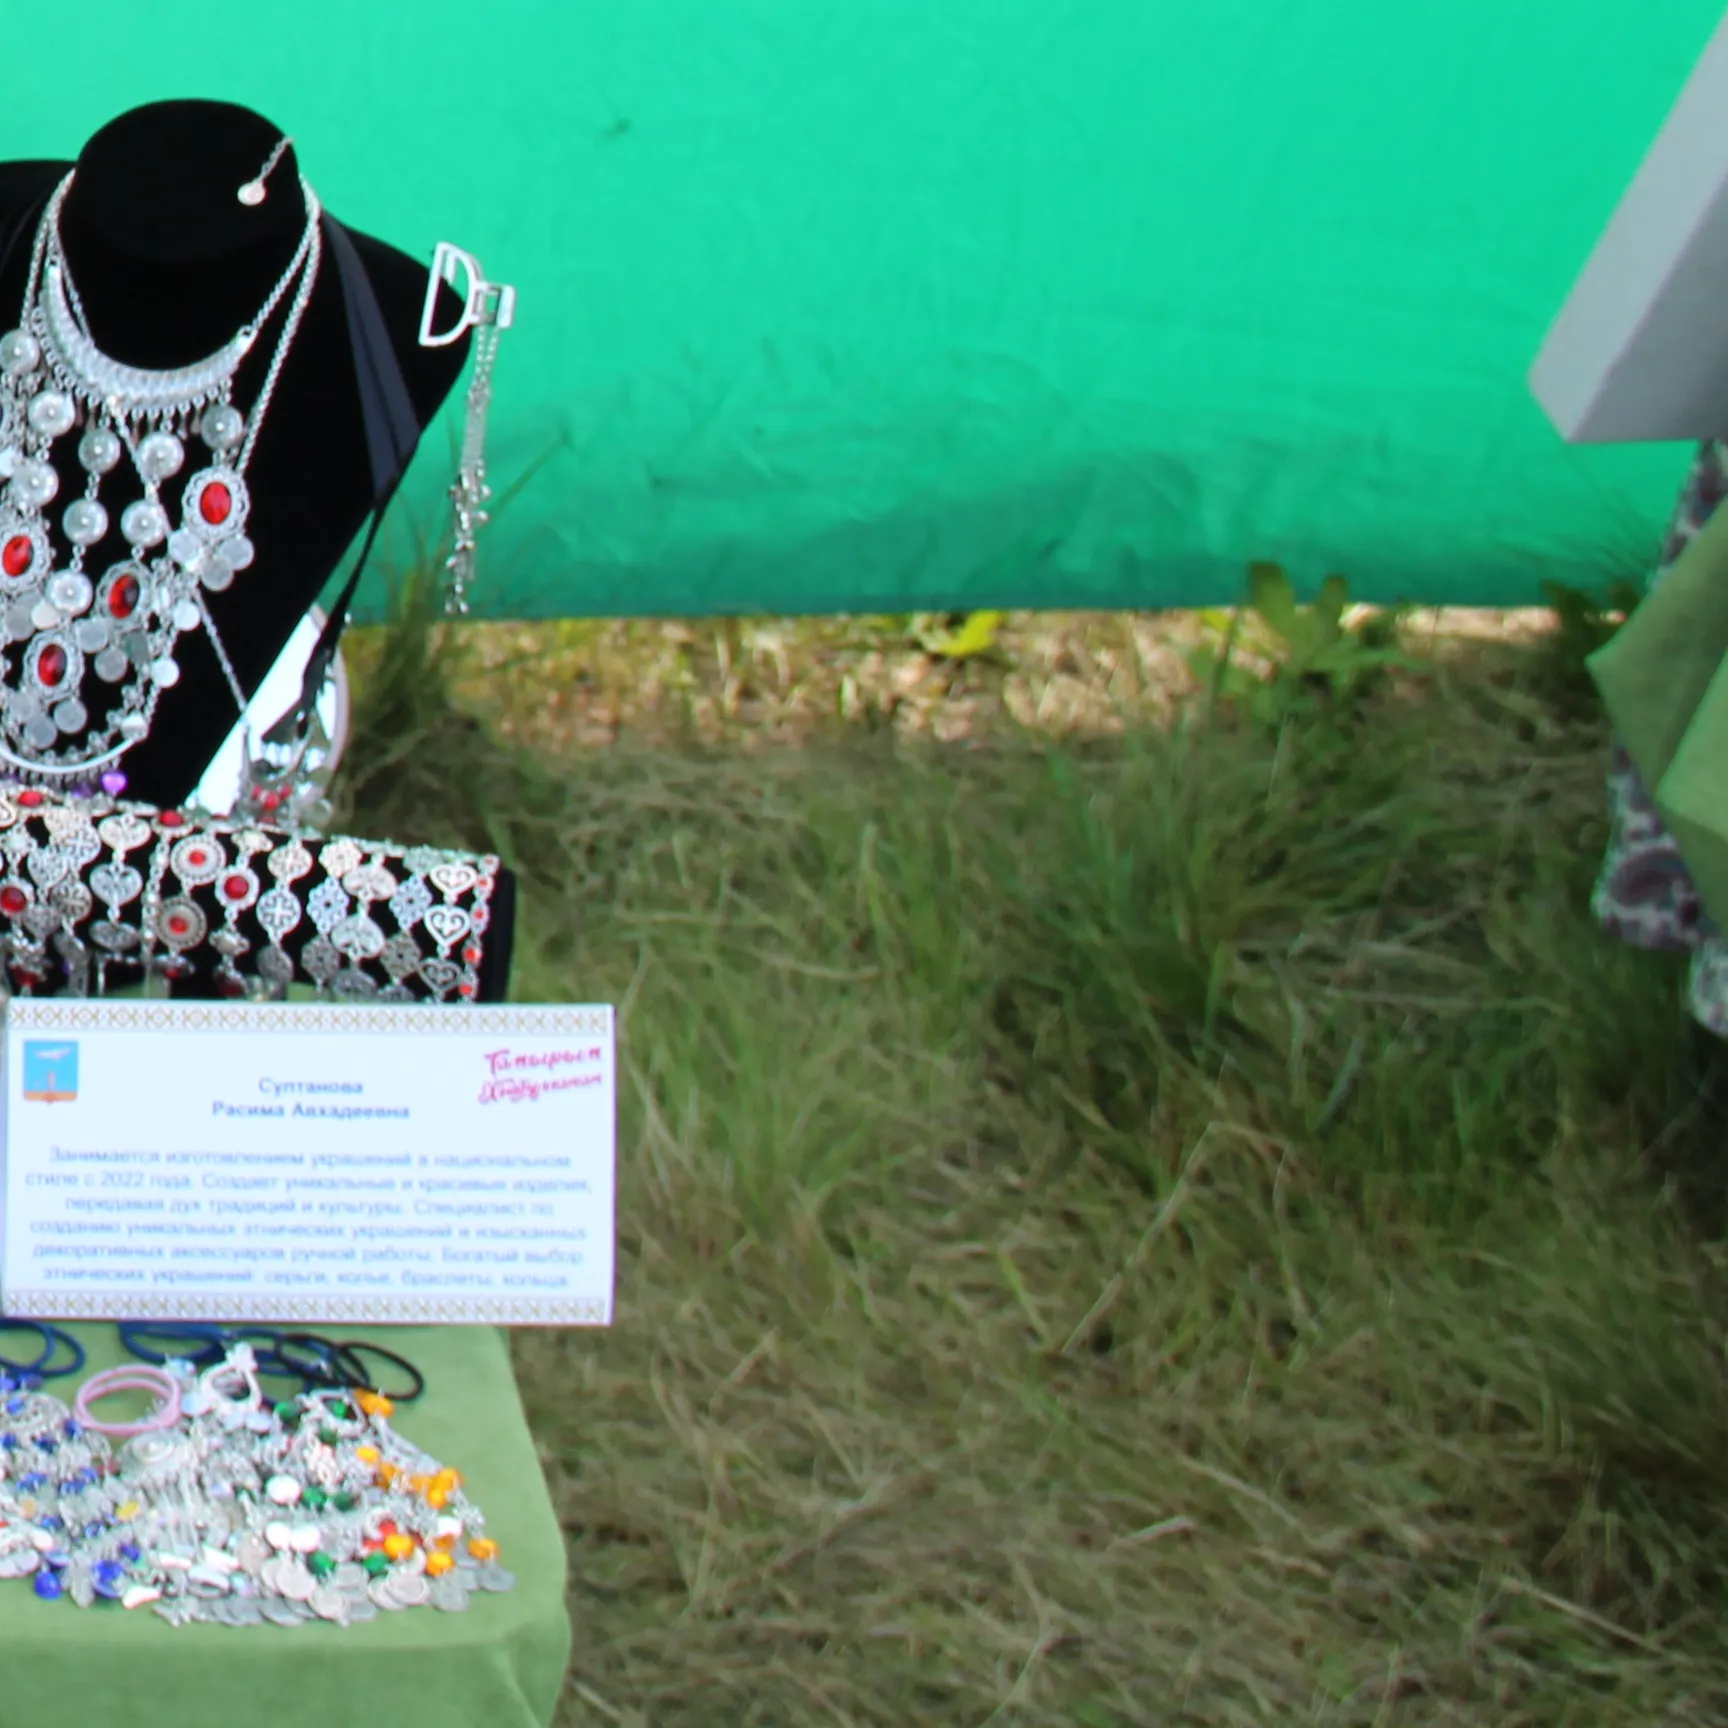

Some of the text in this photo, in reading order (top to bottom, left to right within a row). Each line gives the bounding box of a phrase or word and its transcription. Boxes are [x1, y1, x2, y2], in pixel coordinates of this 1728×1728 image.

[258, 1077, 365, 1097] Султанова
[211, 1101, 411, 1120] Расима Авхадеевна
[100, 1171, 144, 1188] 2022
